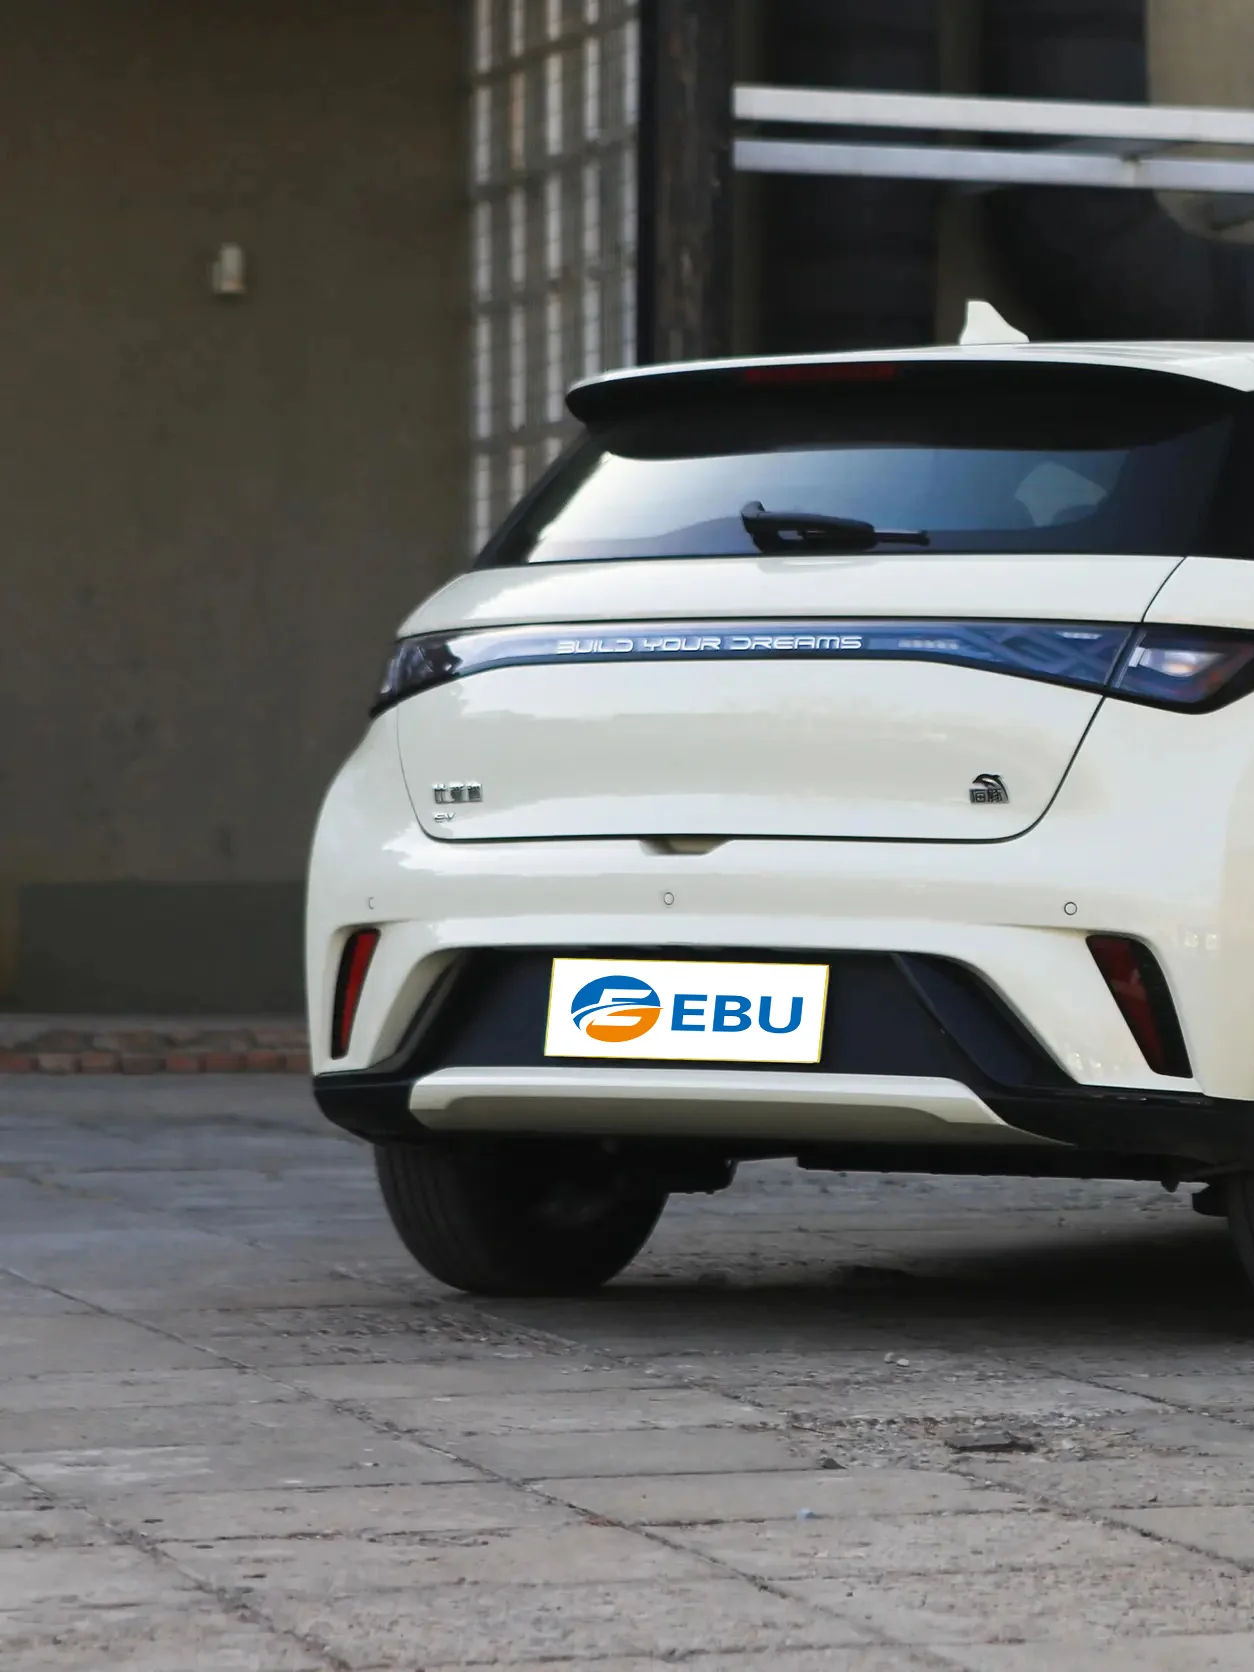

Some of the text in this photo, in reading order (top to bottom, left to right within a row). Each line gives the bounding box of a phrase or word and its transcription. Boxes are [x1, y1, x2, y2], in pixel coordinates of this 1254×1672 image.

[557, 635, 863, 655] BUILD YOUR DREAMS
